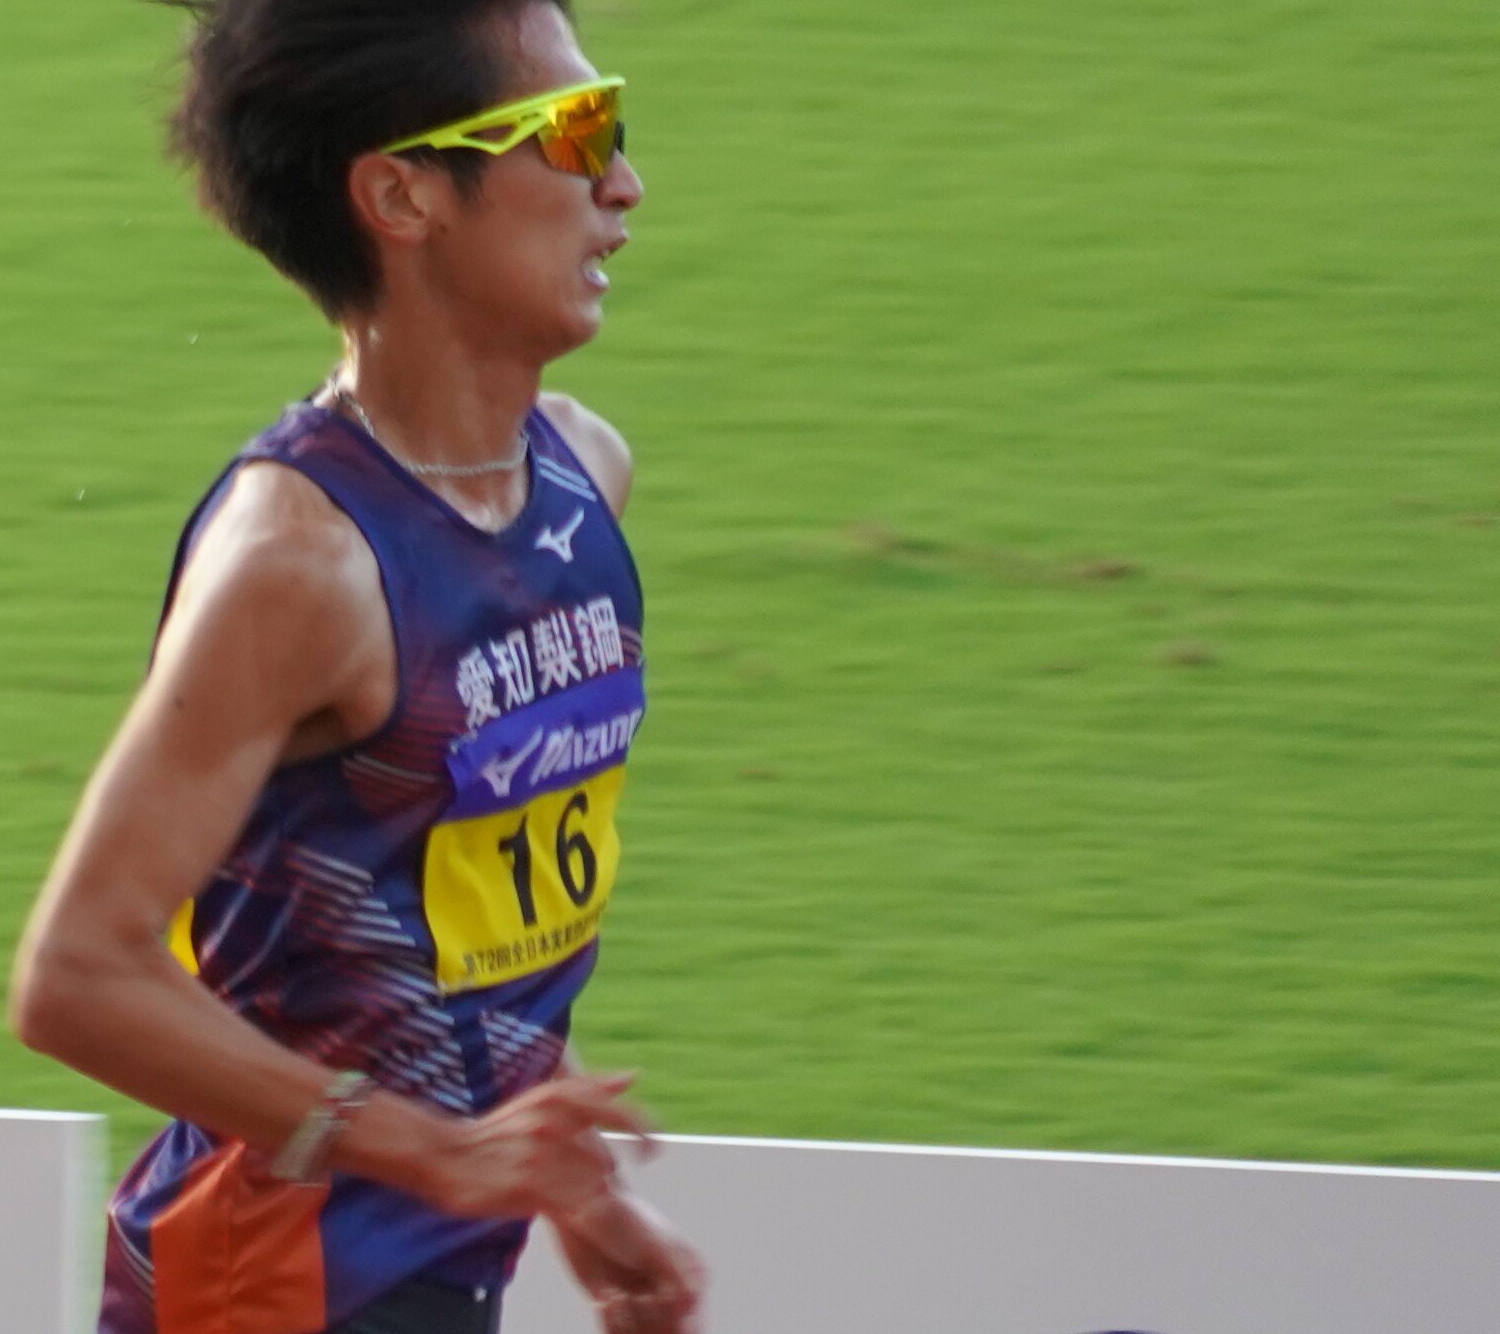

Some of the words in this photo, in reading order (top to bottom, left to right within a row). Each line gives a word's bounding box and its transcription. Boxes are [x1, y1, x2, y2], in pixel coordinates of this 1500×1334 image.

[457, 595, 624, 730] 愛知製鋼
[499, 790, 597, 927] 16
